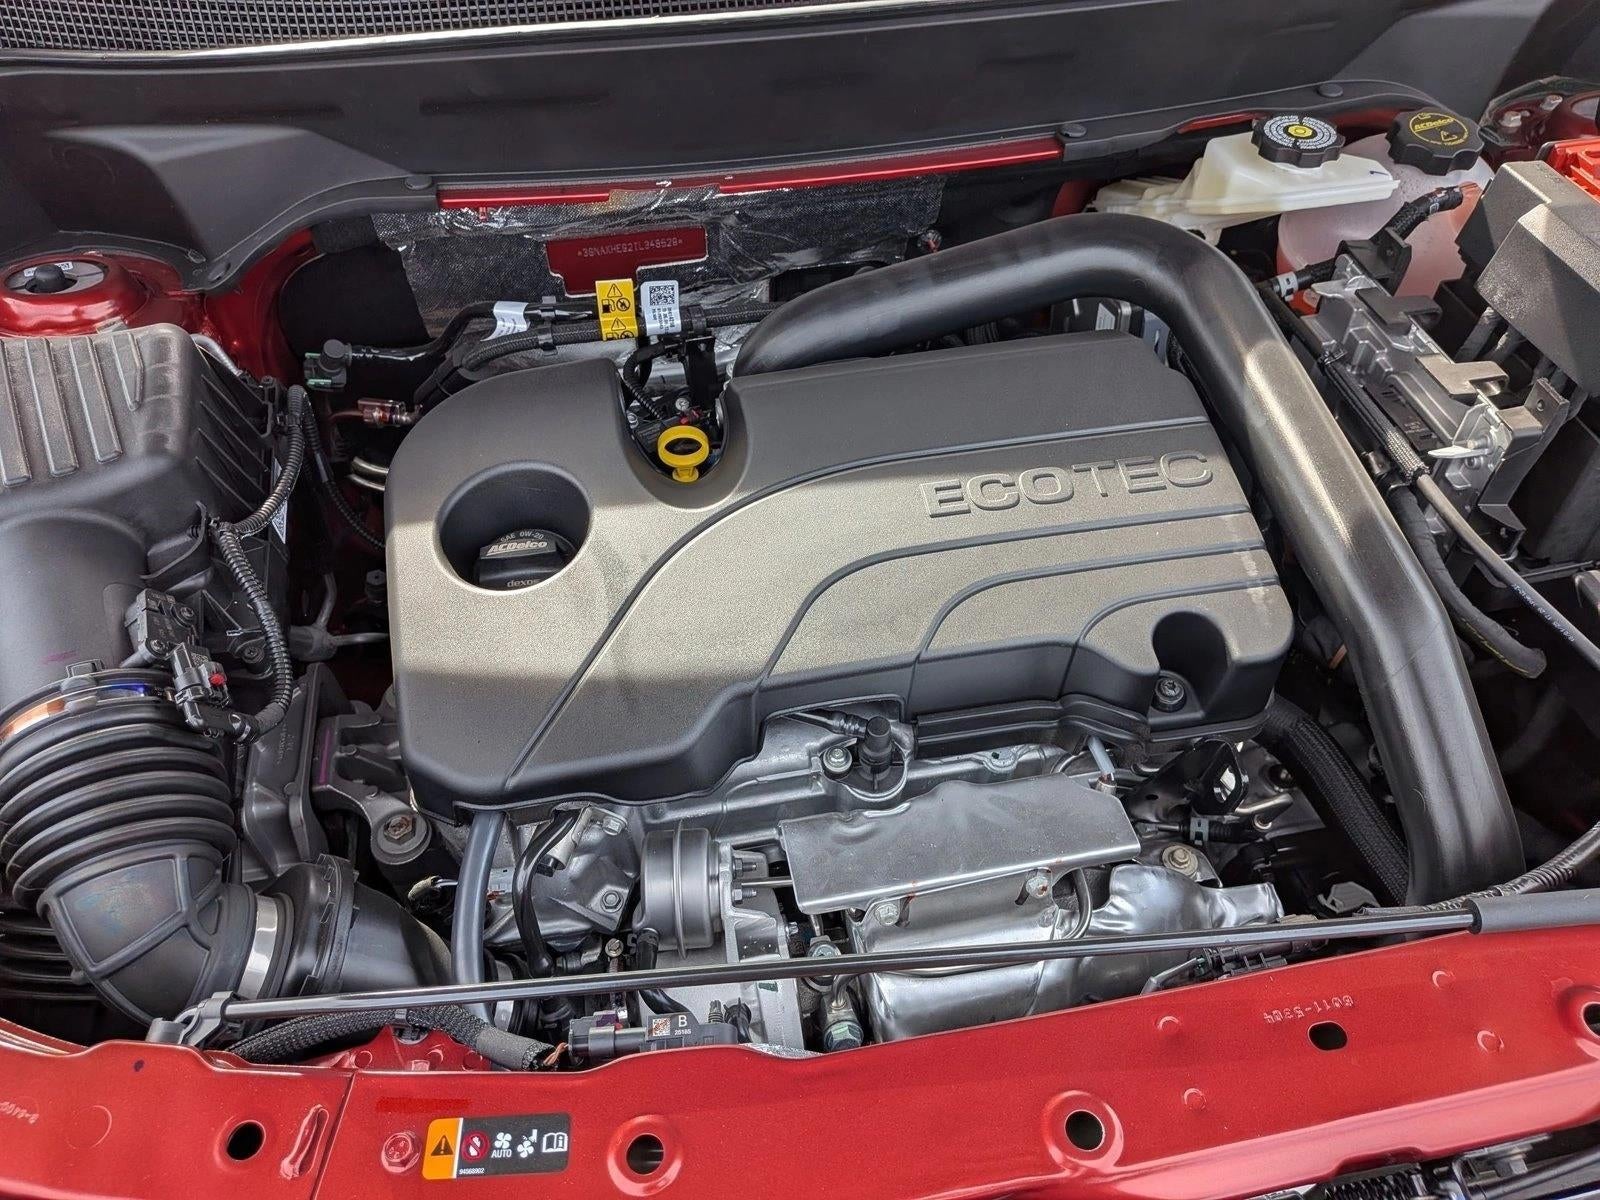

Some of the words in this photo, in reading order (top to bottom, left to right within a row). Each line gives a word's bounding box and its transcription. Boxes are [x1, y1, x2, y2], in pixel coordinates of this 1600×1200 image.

[920, 450, 1213, 518] ECOTEC
[500, 533, 516, 542] SAE
[519, 530, 544, 541] 0W-20
[486, 540, 548, 556] ACDelco
[678, 1014, 688, 1027] B
[491, 1149, 512, 1159] AUTO
